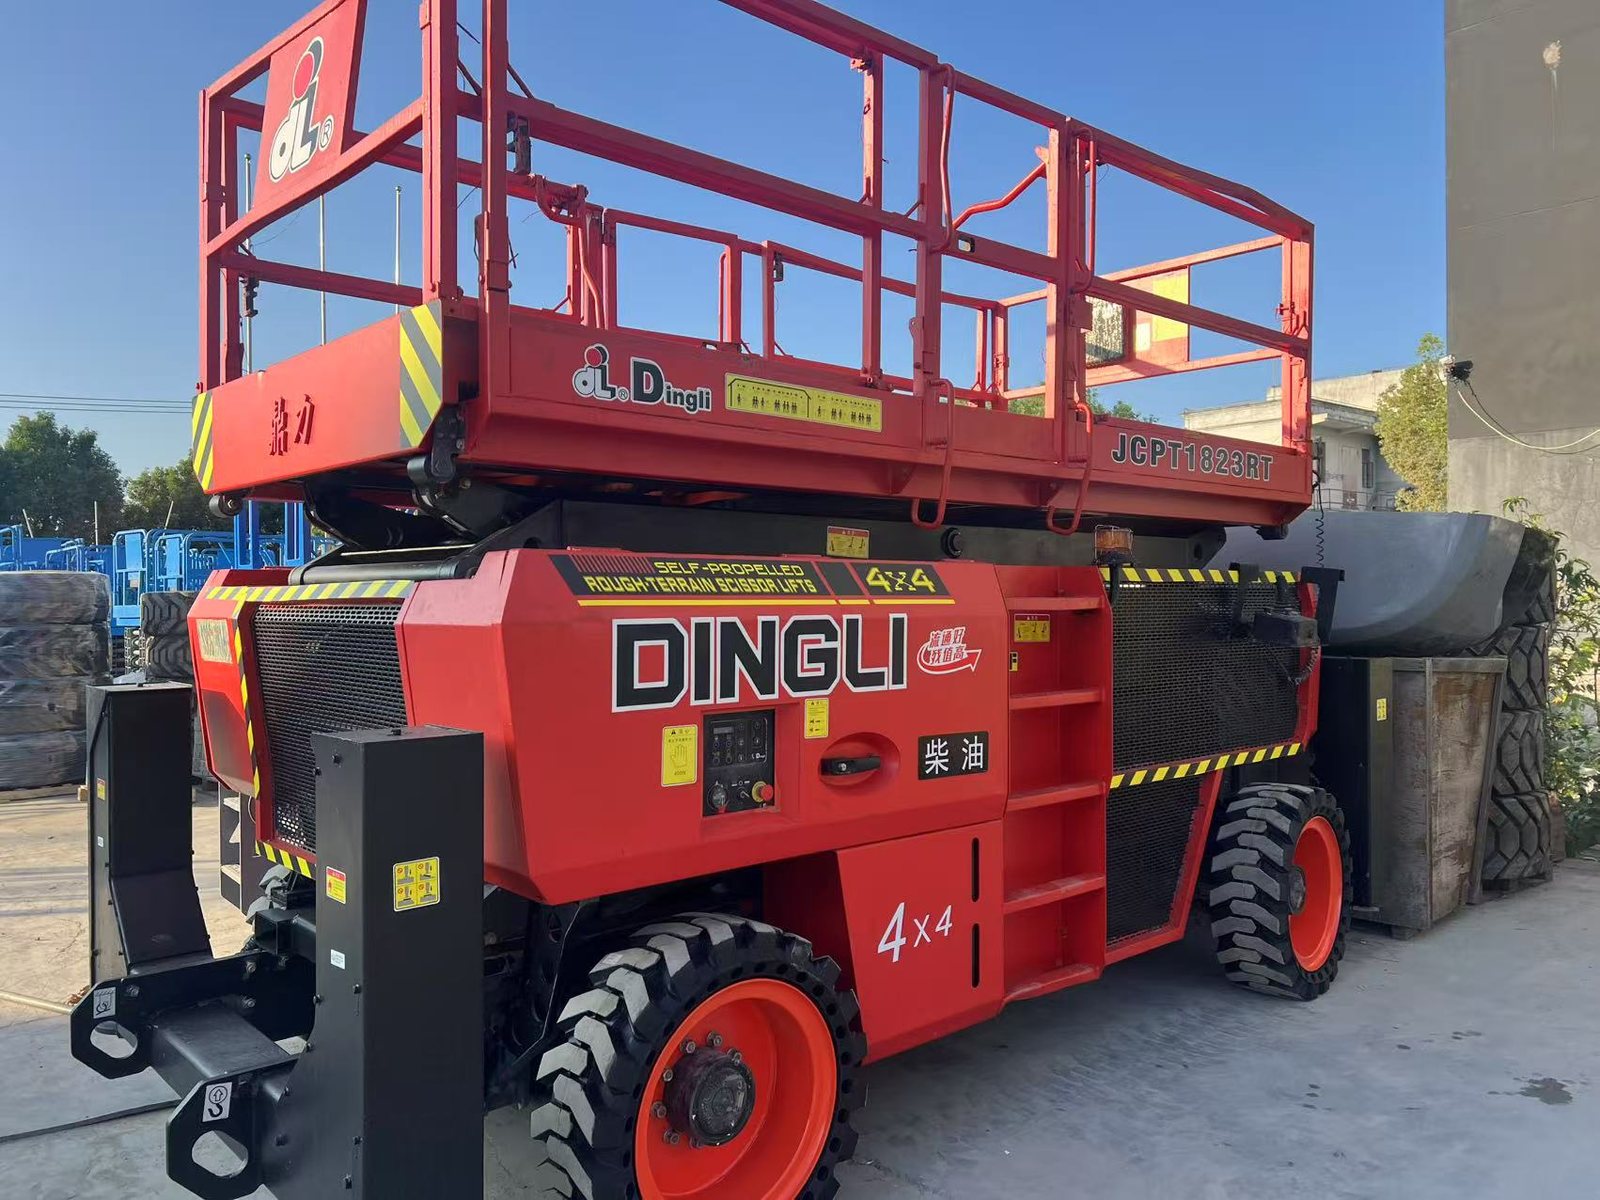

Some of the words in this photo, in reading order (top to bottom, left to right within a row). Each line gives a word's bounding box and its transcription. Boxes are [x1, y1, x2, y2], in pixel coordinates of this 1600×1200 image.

[630, 356, 712, 415] Dingli
[1111, 432, 1274, 482] JCPT1823RT
[653, 561, 805, 577] SELF-PROPELLED
[715, 577, 781, 593] SCISSOR
[779, 579, 818, 594] LIFTS
[612, 613, 908, 713] DINGLI
[924, 735, 984, 775] 柴油
